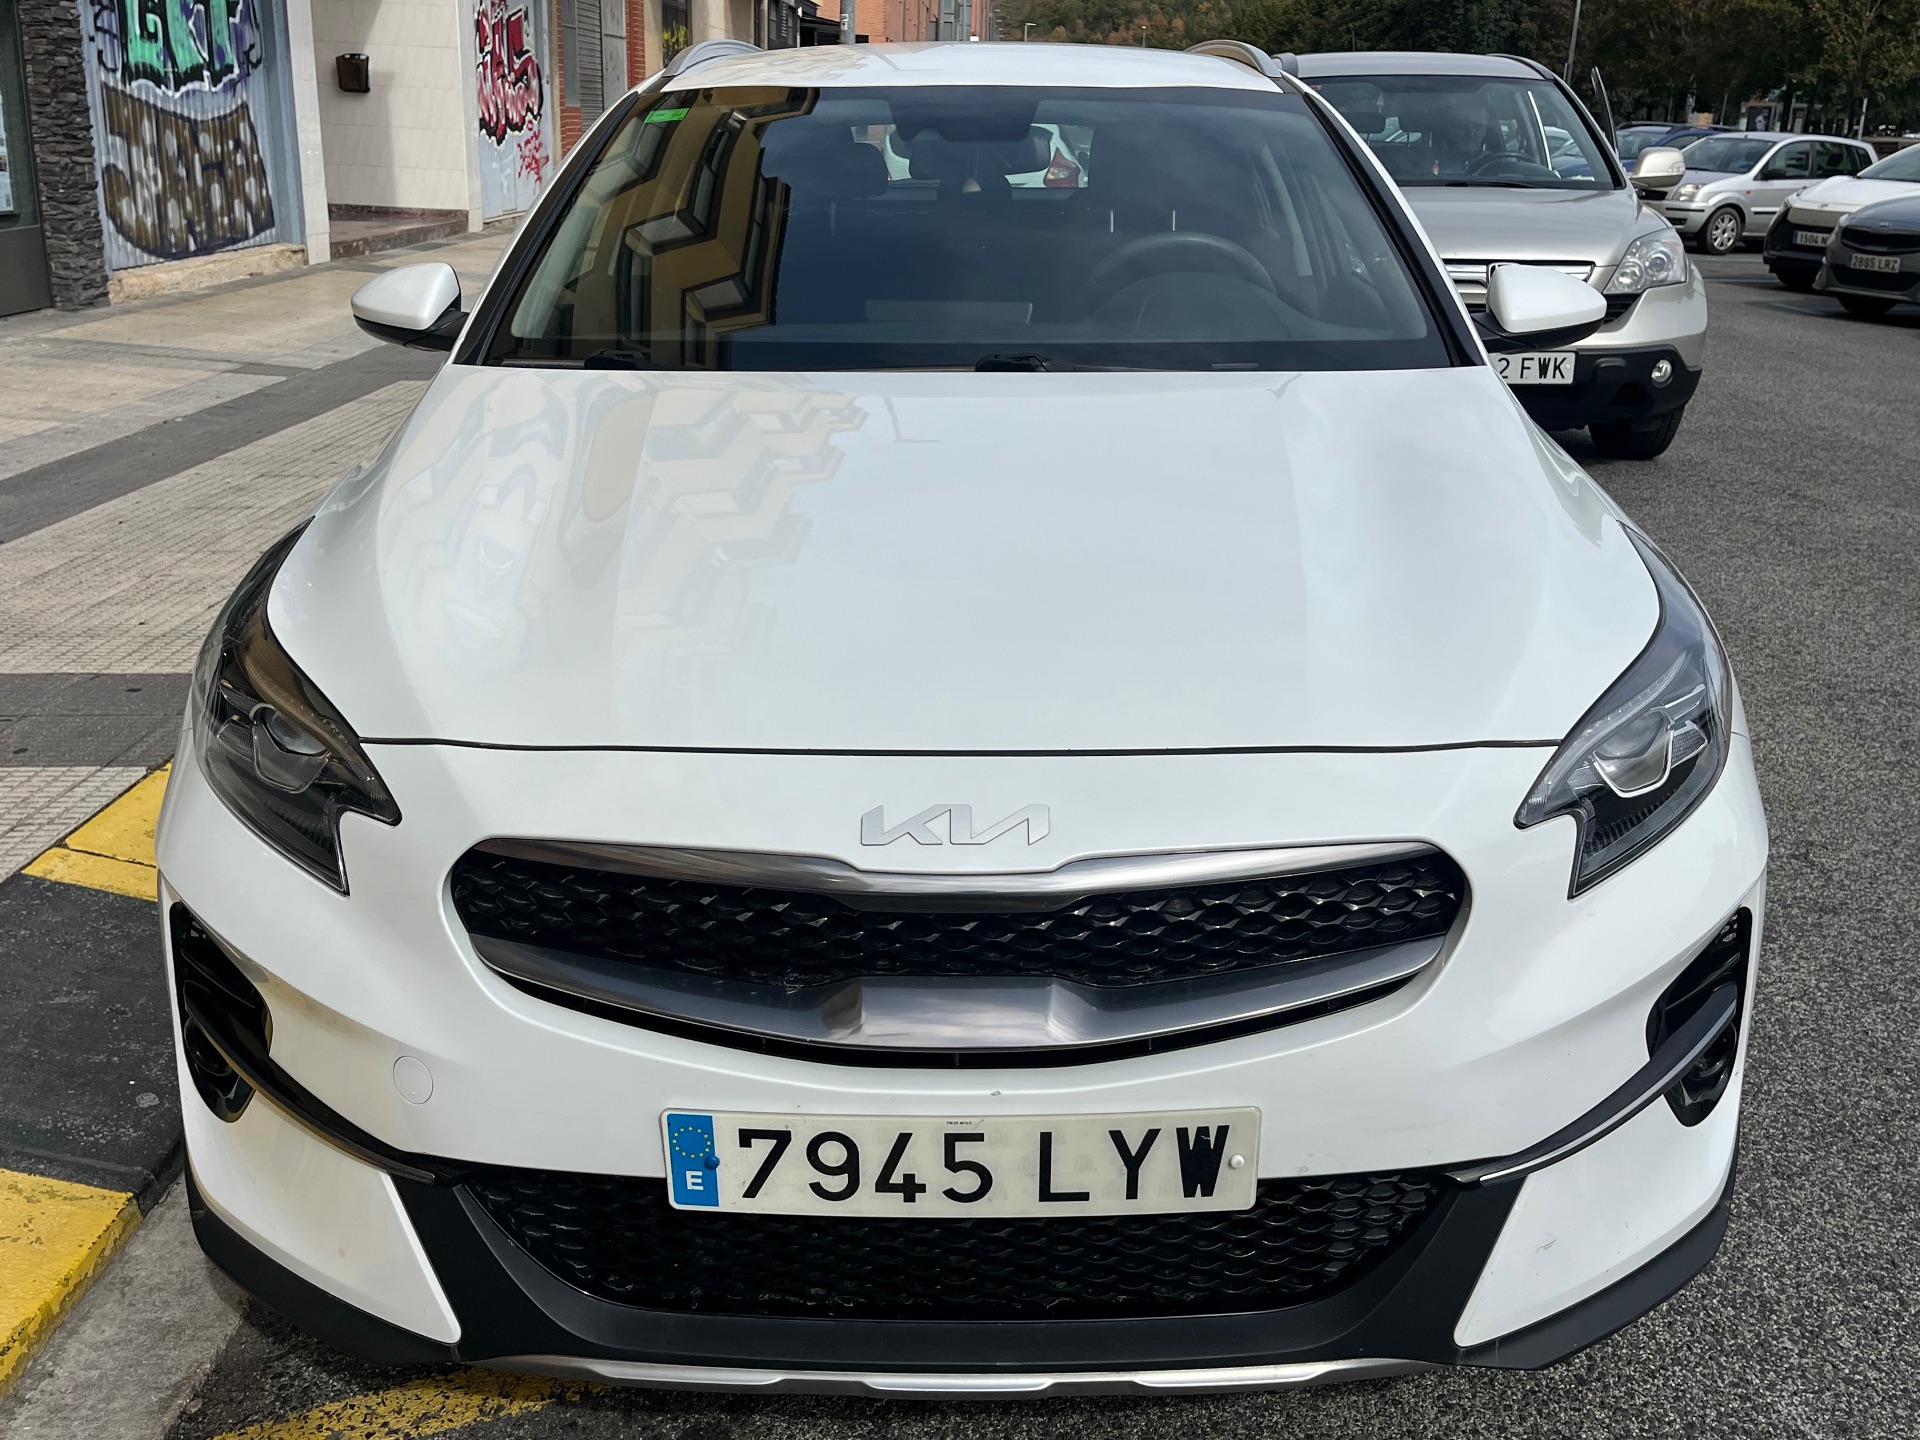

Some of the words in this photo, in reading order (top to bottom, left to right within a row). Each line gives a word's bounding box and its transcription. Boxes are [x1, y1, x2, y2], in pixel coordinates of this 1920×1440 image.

[1520, 357, 1567, 379] FWK
[738, 1128, 994, 1203] 7945
[1038, 1124, 1230, 1203] LYW
[685, 1170, 704, 1191] E
